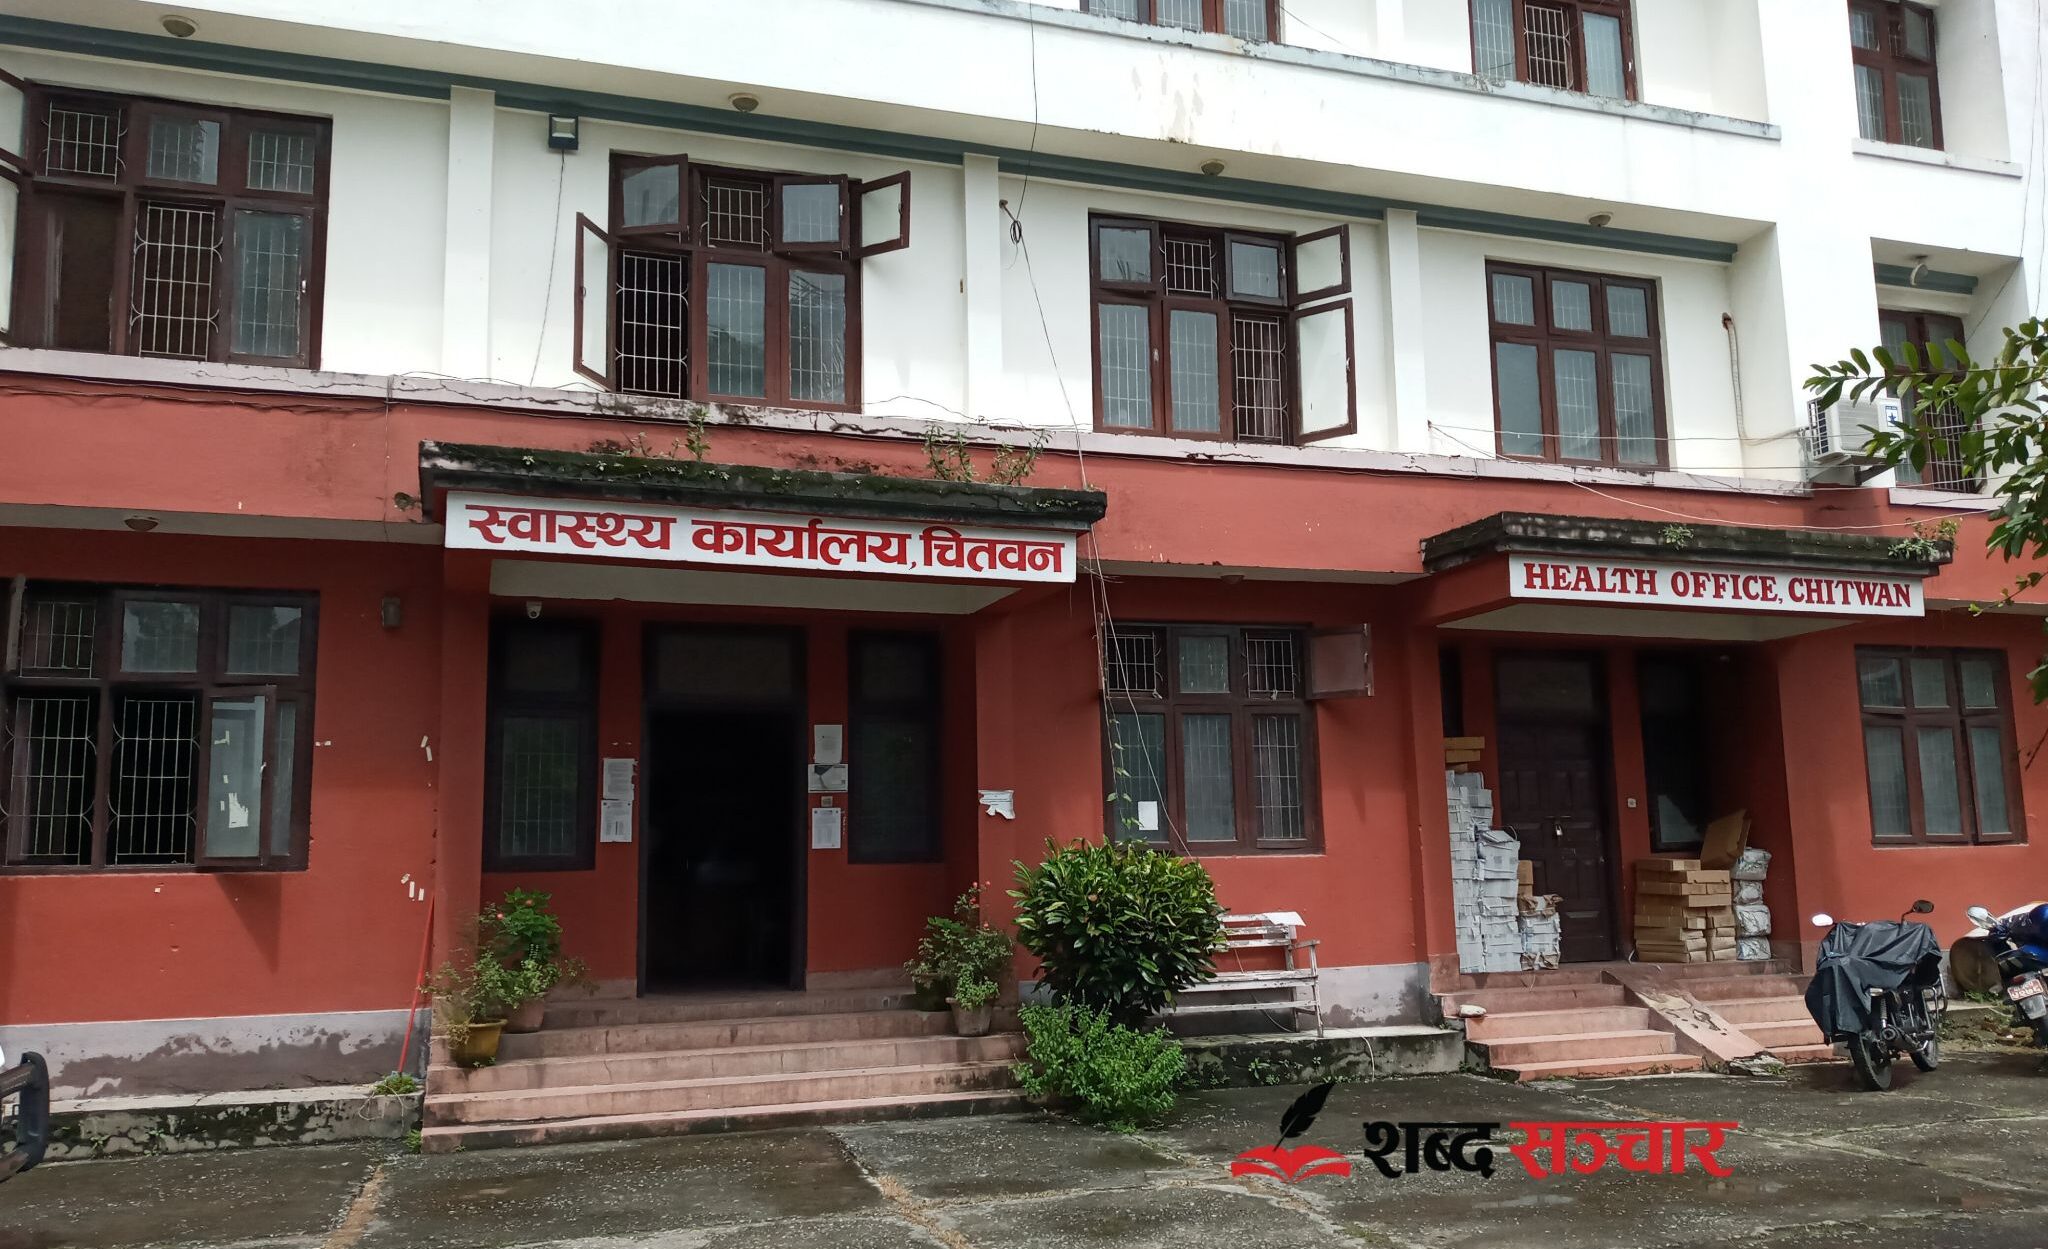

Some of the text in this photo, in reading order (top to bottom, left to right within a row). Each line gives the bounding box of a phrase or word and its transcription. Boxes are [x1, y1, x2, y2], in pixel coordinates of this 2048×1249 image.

[920, 526, 1065, 573] चितवन
[1523, 562, 1911, 607] HEALTH OFFICE, CHITWAN
